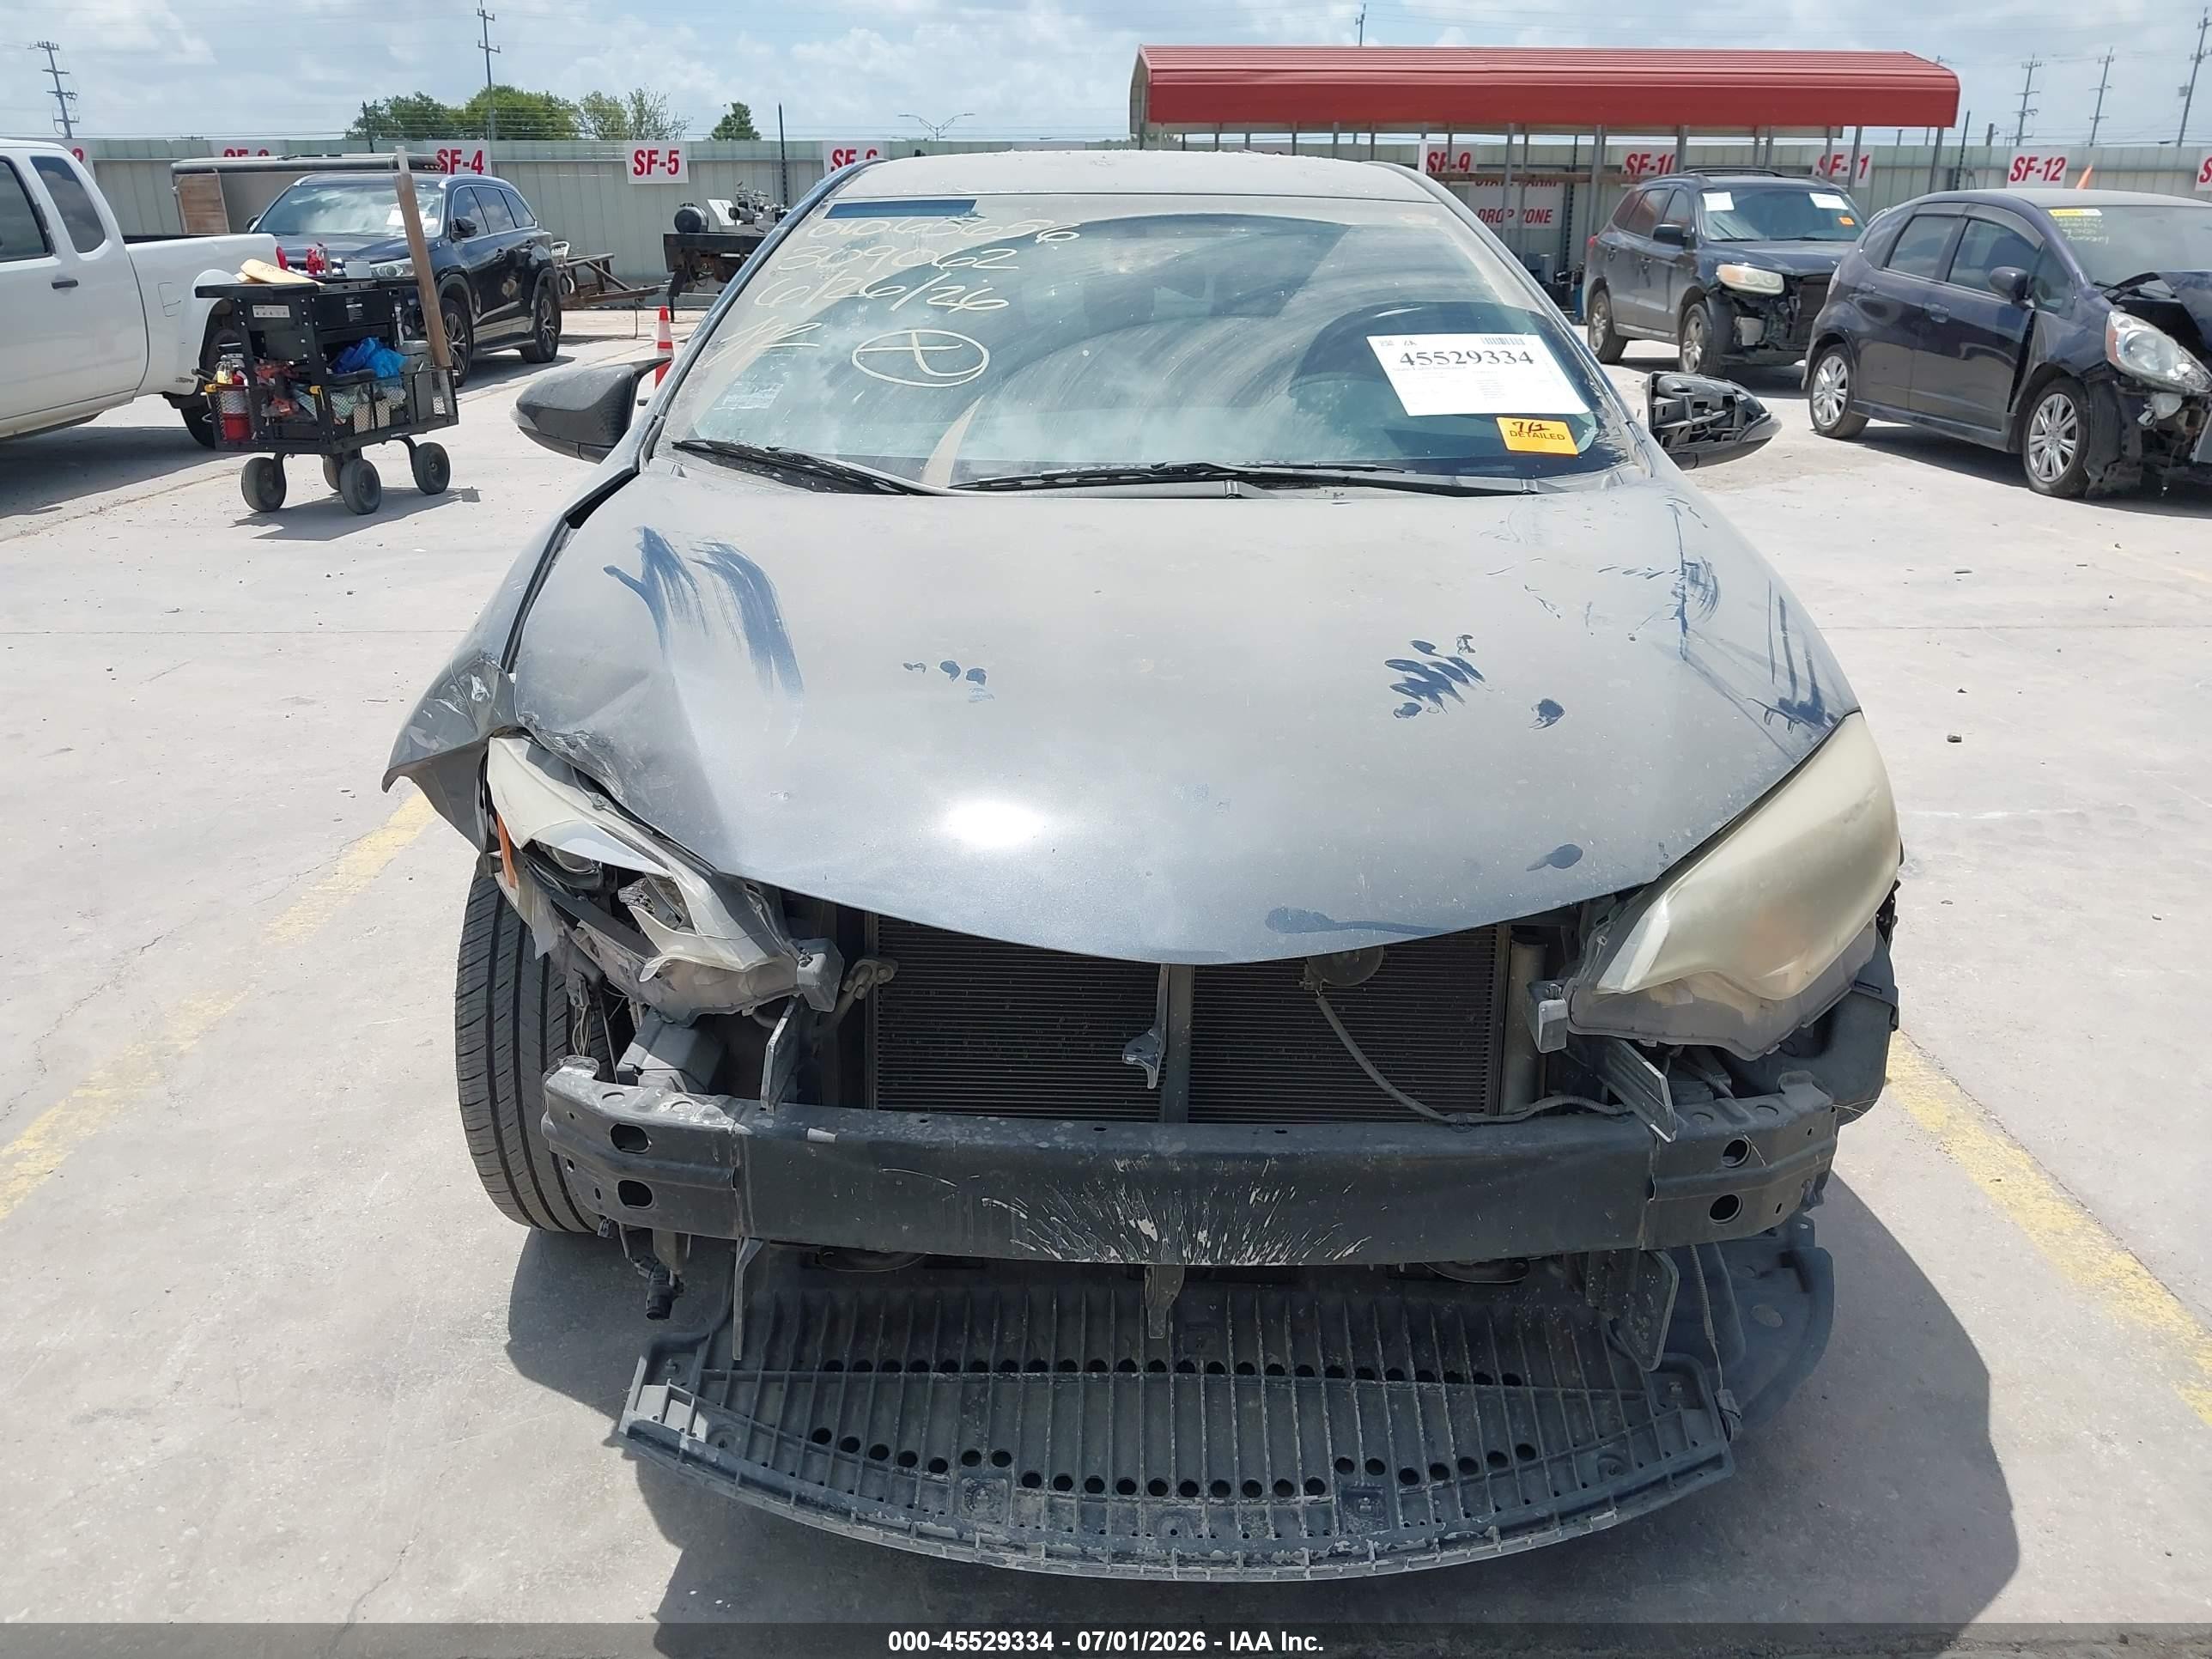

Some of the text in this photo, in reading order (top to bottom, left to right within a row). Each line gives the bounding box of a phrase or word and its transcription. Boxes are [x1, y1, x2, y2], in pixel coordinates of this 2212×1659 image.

[437, 149, 483, 174] SF-4
[633, 149, 679, 175] SF-5
[830, 149, 878, 172] SF
[1816, 155, 1870, 179] F-1
[2009, 155, 2066, 182] SF-12
[1522, 208, 1553, 223] ONE
[755, 270, 1010, 313] 6/26/26
[1400, 350, 1534, 366] 45529334
[1510, 430, 1565, 441] DETAILED
